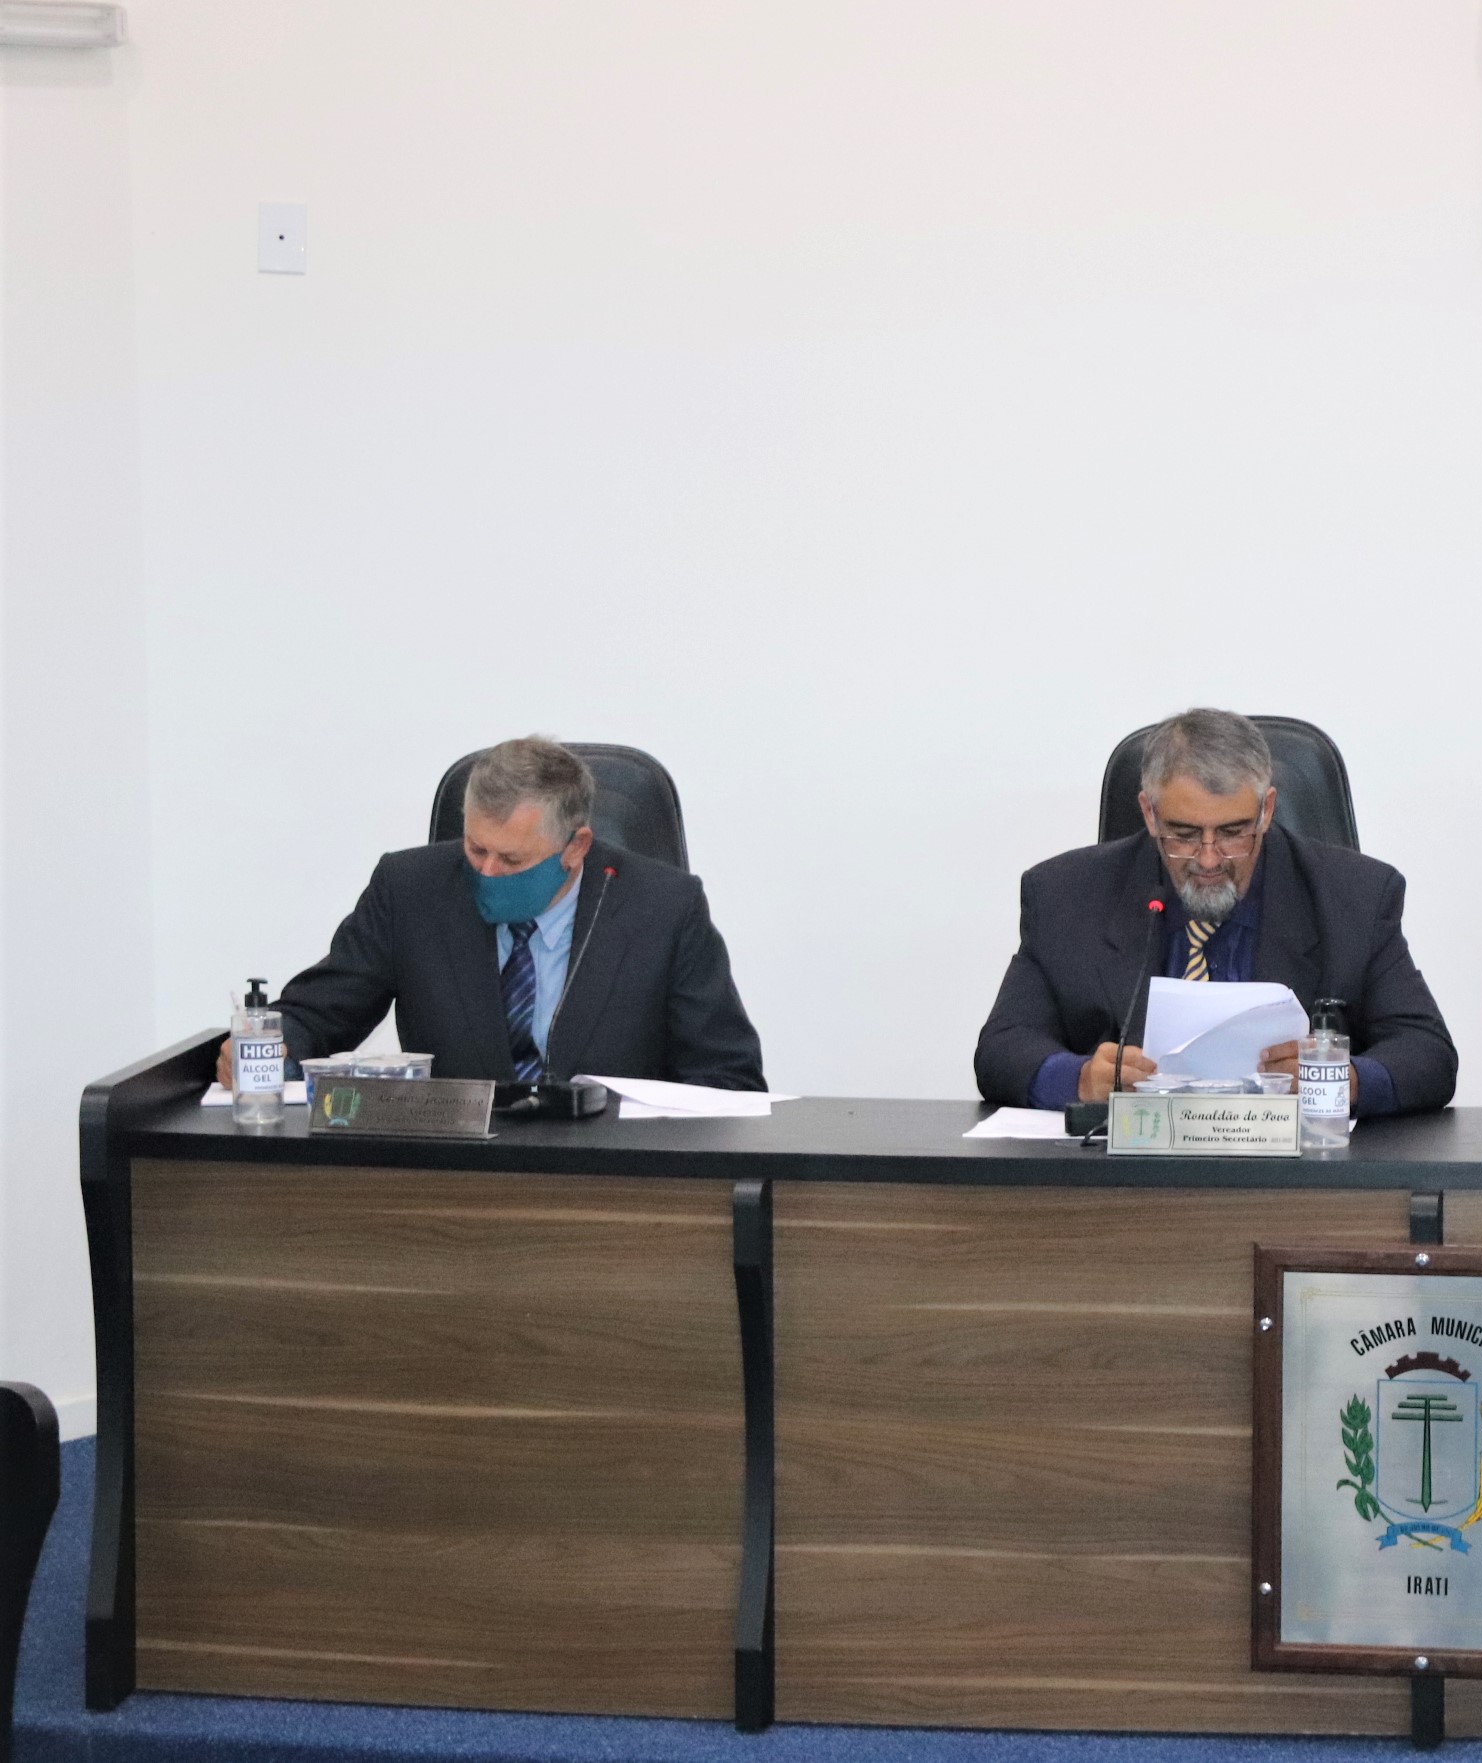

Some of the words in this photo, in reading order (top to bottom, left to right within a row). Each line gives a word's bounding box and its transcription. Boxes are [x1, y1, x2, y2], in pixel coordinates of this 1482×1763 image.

[253, 1074, 271, 1082] GEL
[1302, 1096, 1317, 1105] GEL
[1180, 1109, 1240, 1121] Ronaldão
[1243, 1110, 1257, 1121] do
[1212, 1126, 1251, 1134] Vereador
[1183, 1134, 1220, 1142] Primeiro
[1222, 1134, 1267, 1143] Secretário
[1350, 1317, 1416, 1356] CÂMARA
[1407, 1575, 1449, 1597] IRATI
